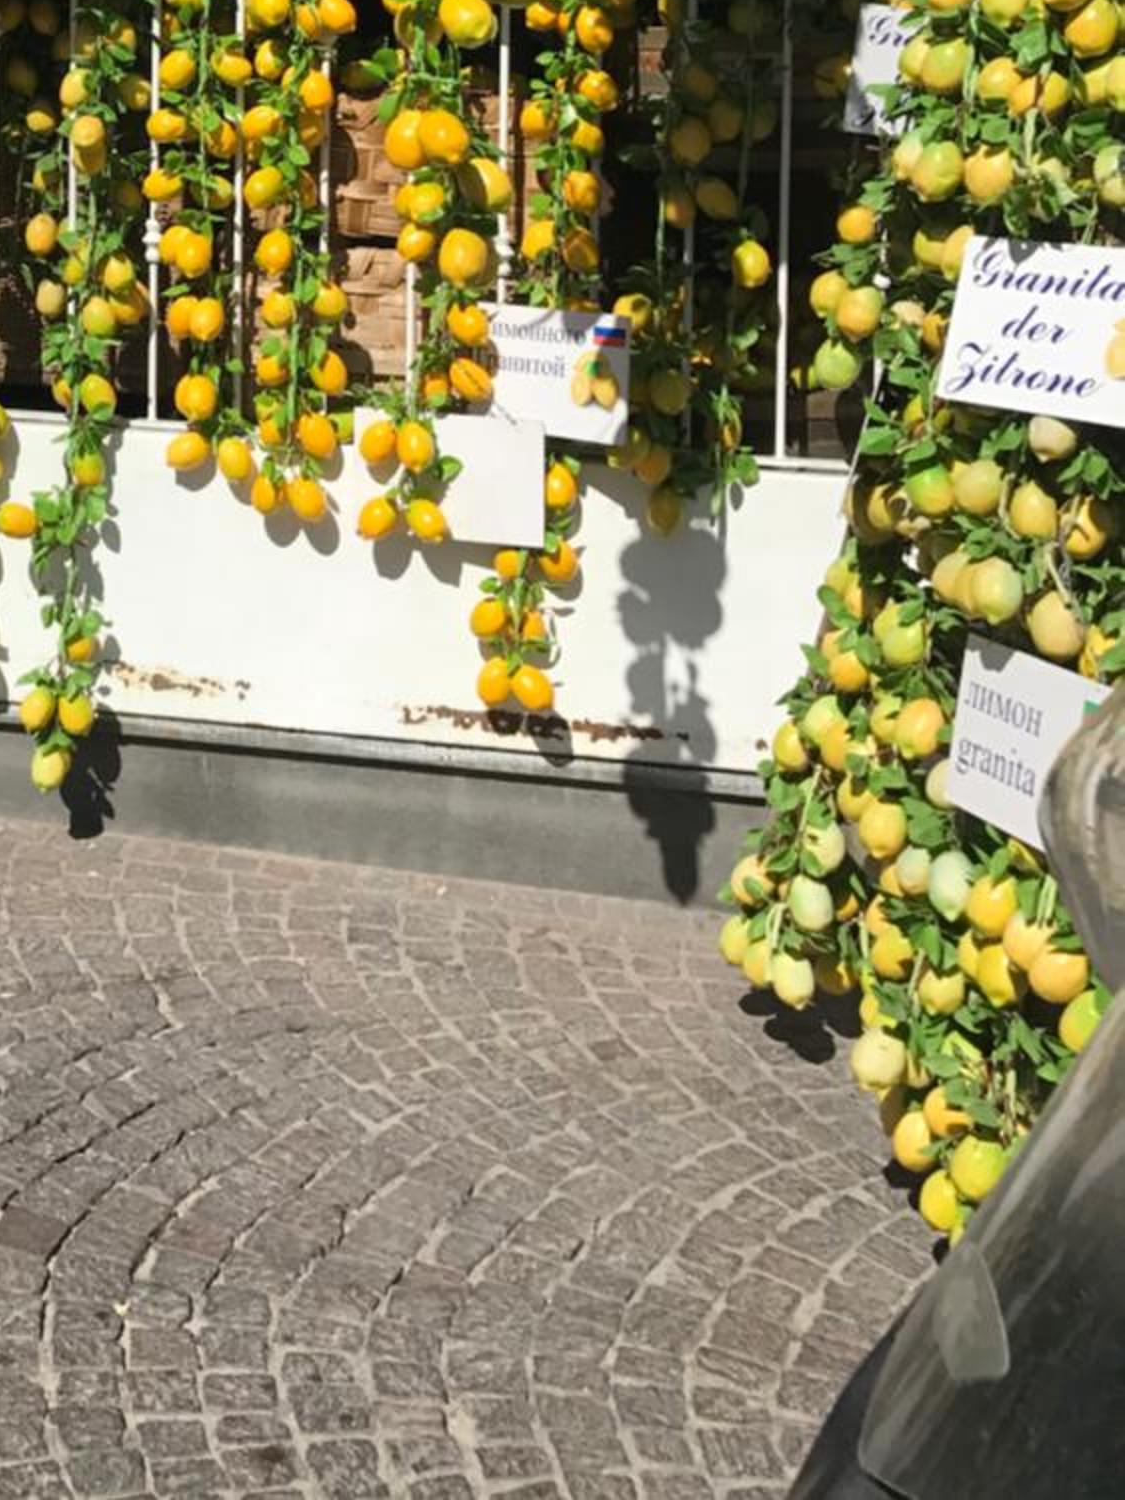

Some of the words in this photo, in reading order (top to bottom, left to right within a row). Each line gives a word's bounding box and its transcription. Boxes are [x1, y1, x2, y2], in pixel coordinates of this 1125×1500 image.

[973, 250, 1125, 302] Granita
[1001, 304, 1071, 344] der
[945, 342, 1105, 398] Zitrone
[955, 738, 1036, 797] granita
